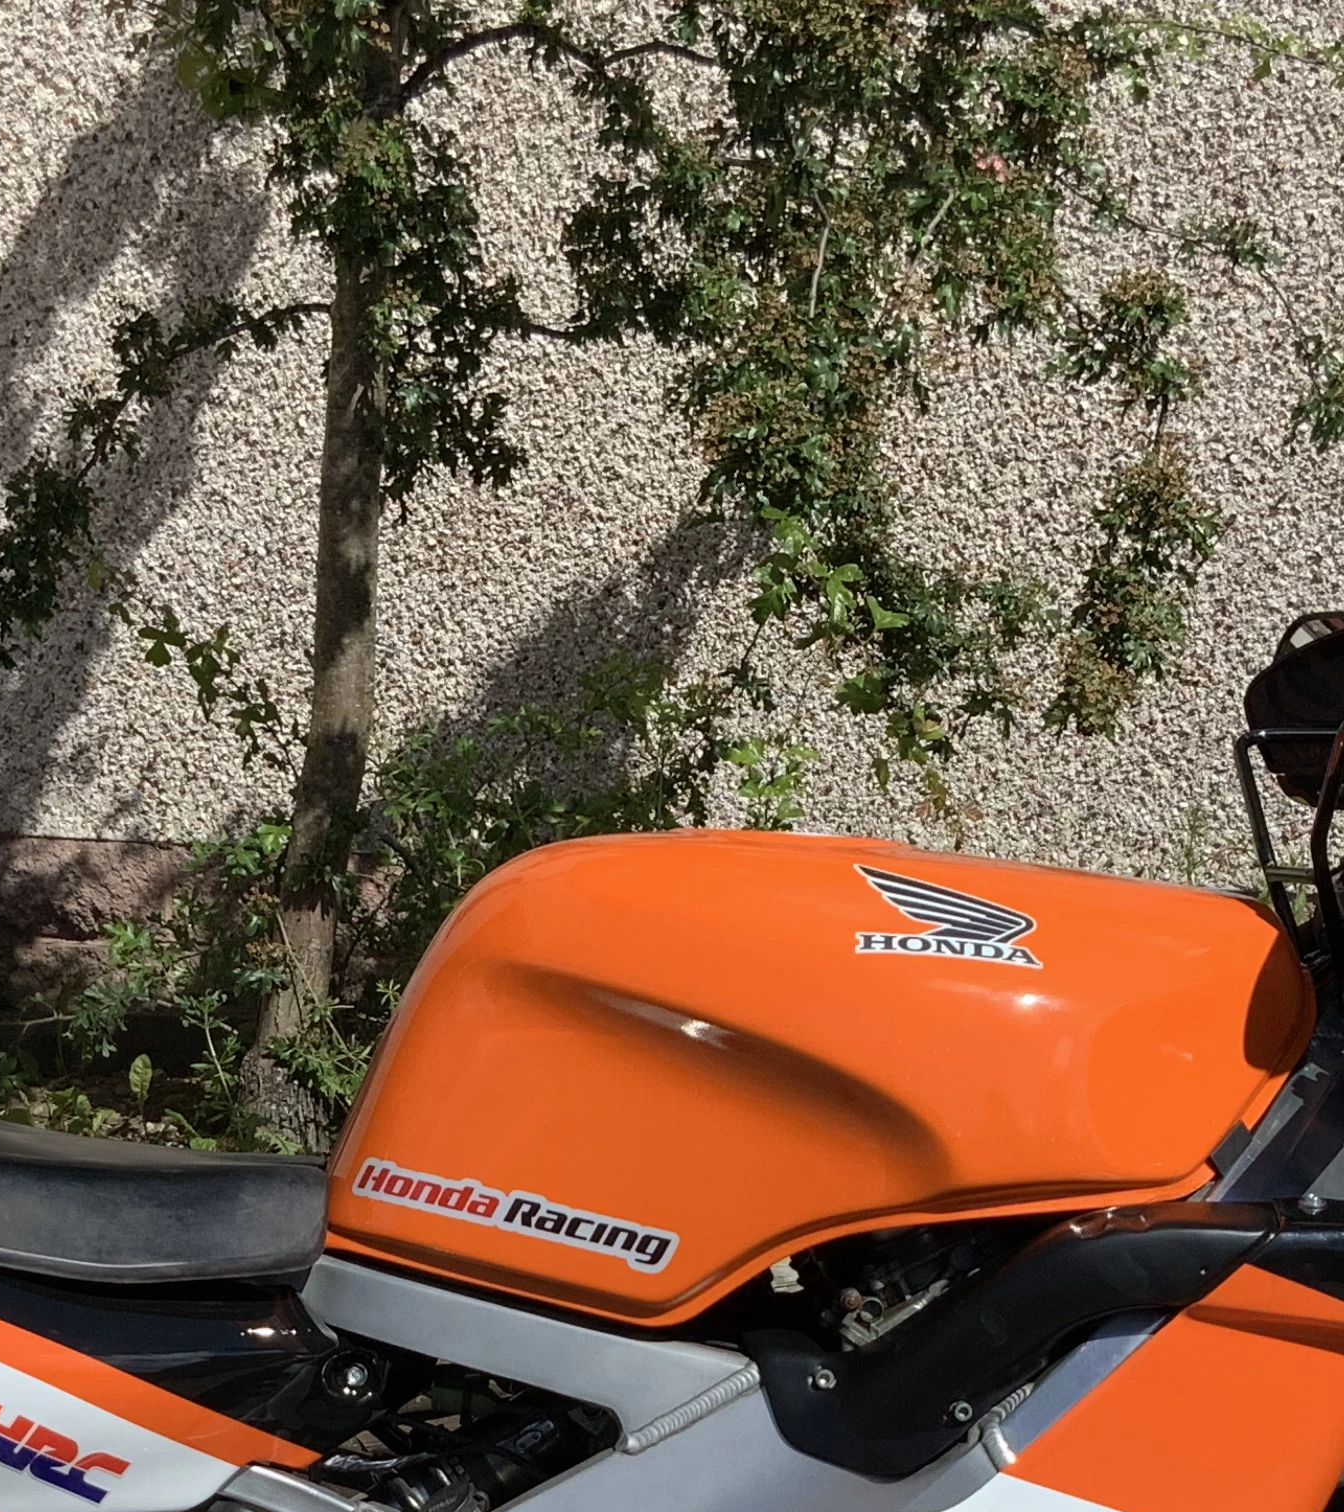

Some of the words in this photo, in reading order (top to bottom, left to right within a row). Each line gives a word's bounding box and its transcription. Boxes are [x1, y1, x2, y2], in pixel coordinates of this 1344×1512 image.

[858, 934, 1041, 967] HONDA
[358, 1163, 500, 1219] Honda
[503, 1198, 673, 1267] Racing
